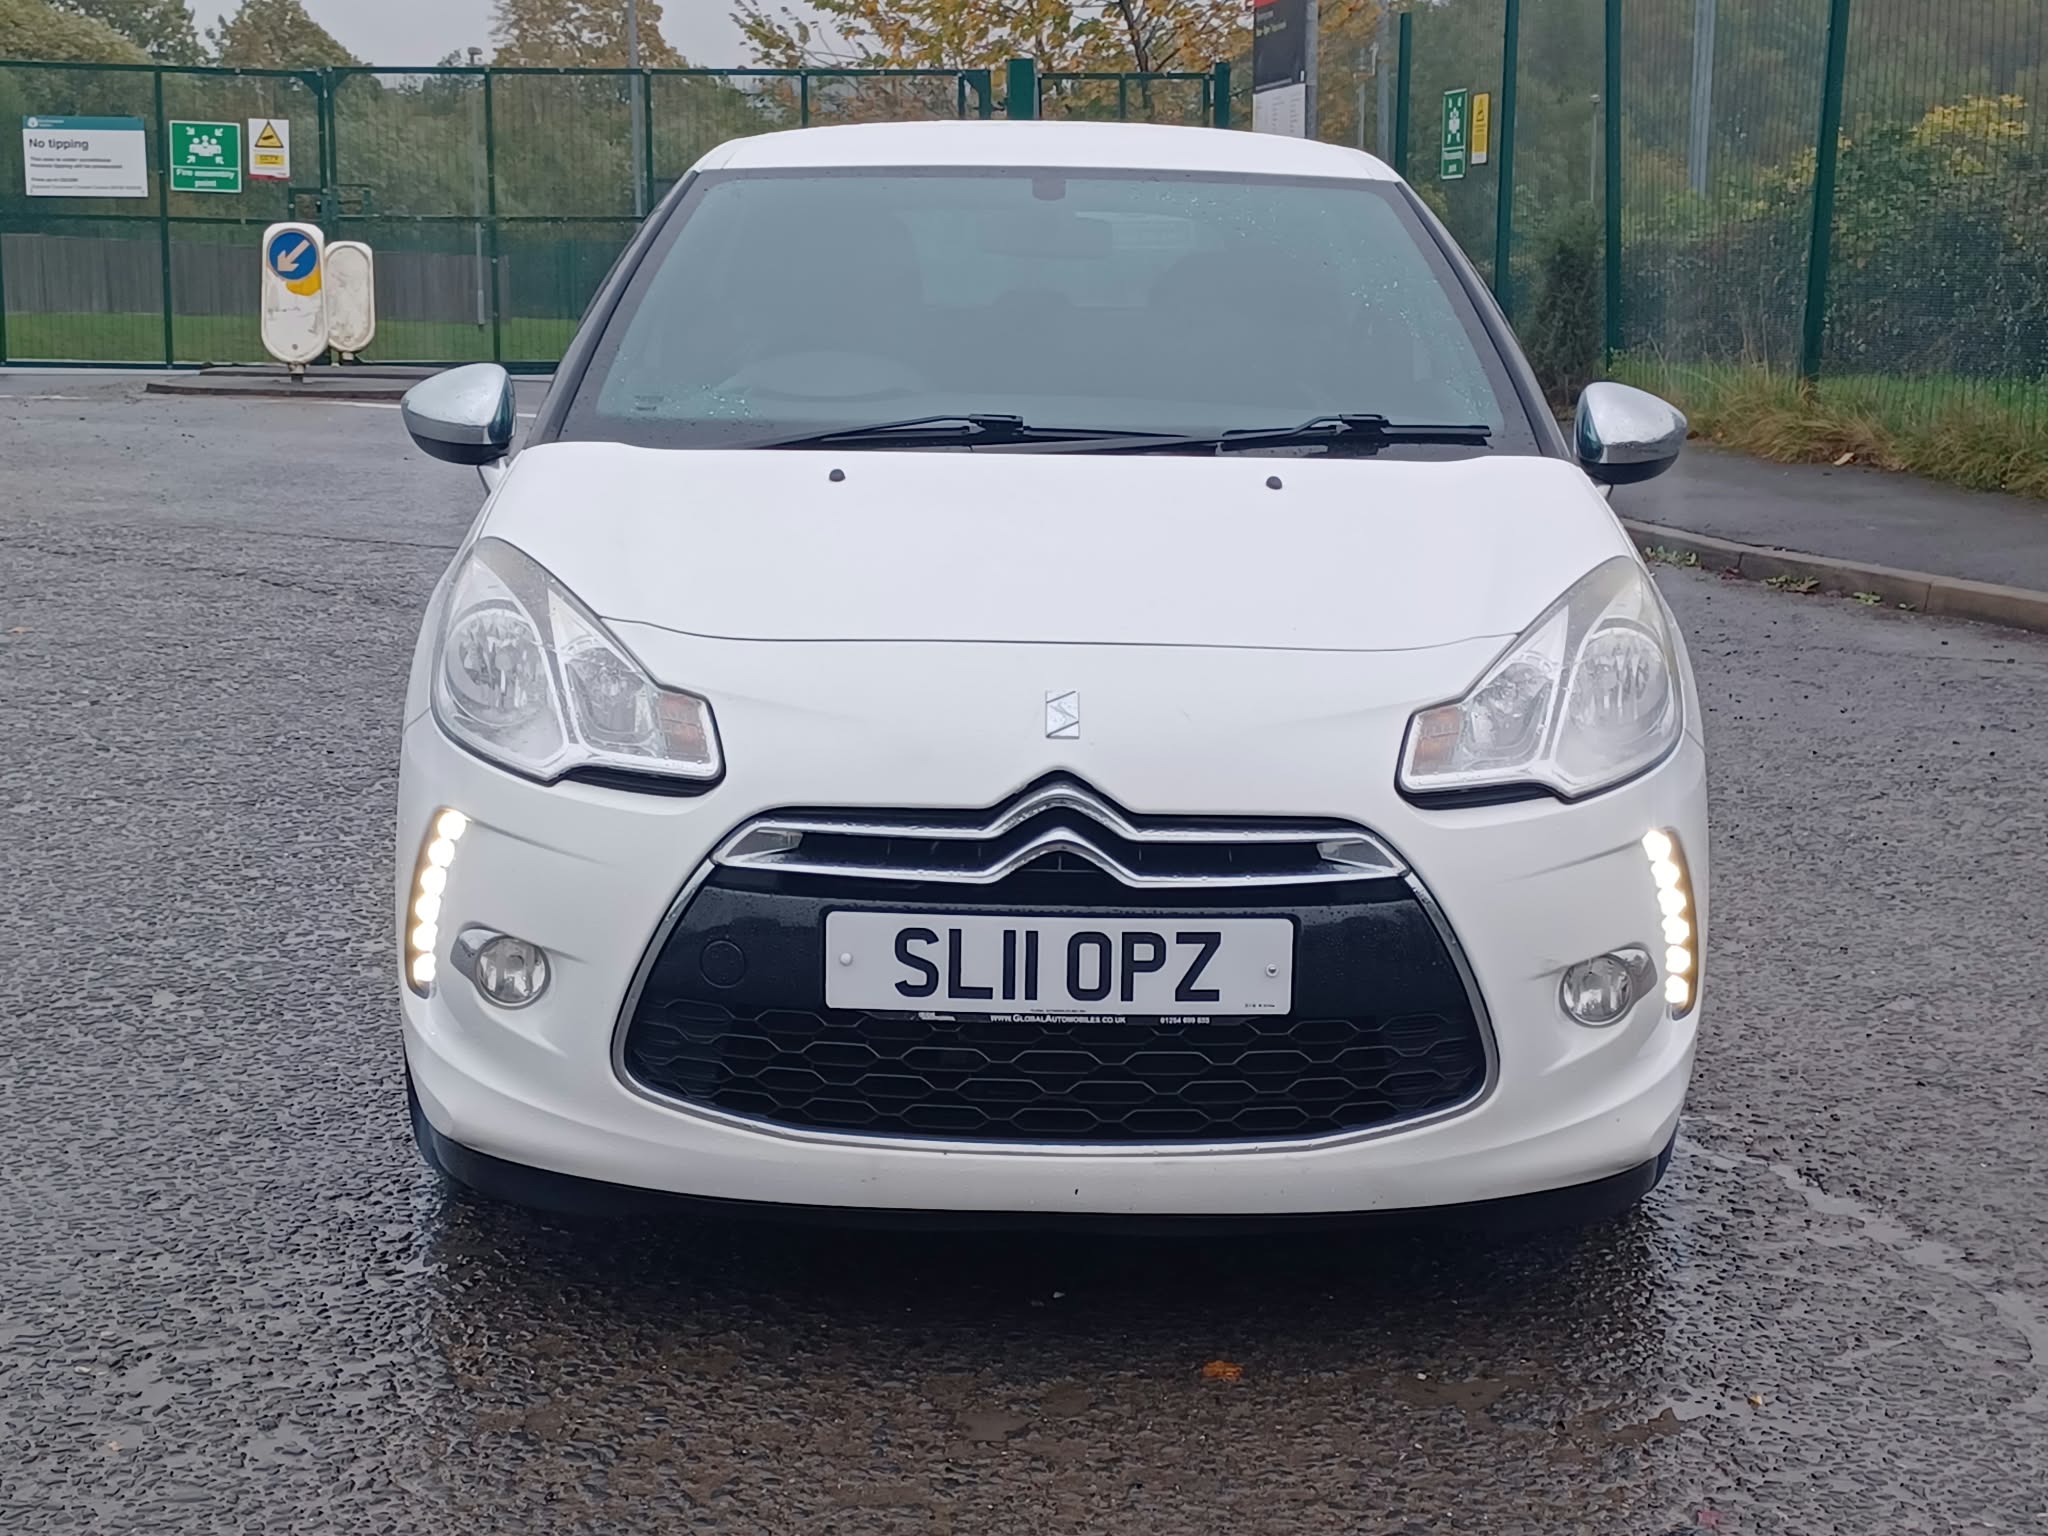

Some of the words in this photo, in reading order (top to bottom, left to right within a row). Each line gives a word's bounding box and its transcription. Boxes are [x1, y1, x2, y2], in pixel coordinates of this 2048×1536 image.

[29, 138, 45, 149] No
[48, 138, 89, 151] tipping
[894, 927, 1039, 1000] SL11
[1066, 931, 1222, 1002] OPZ
